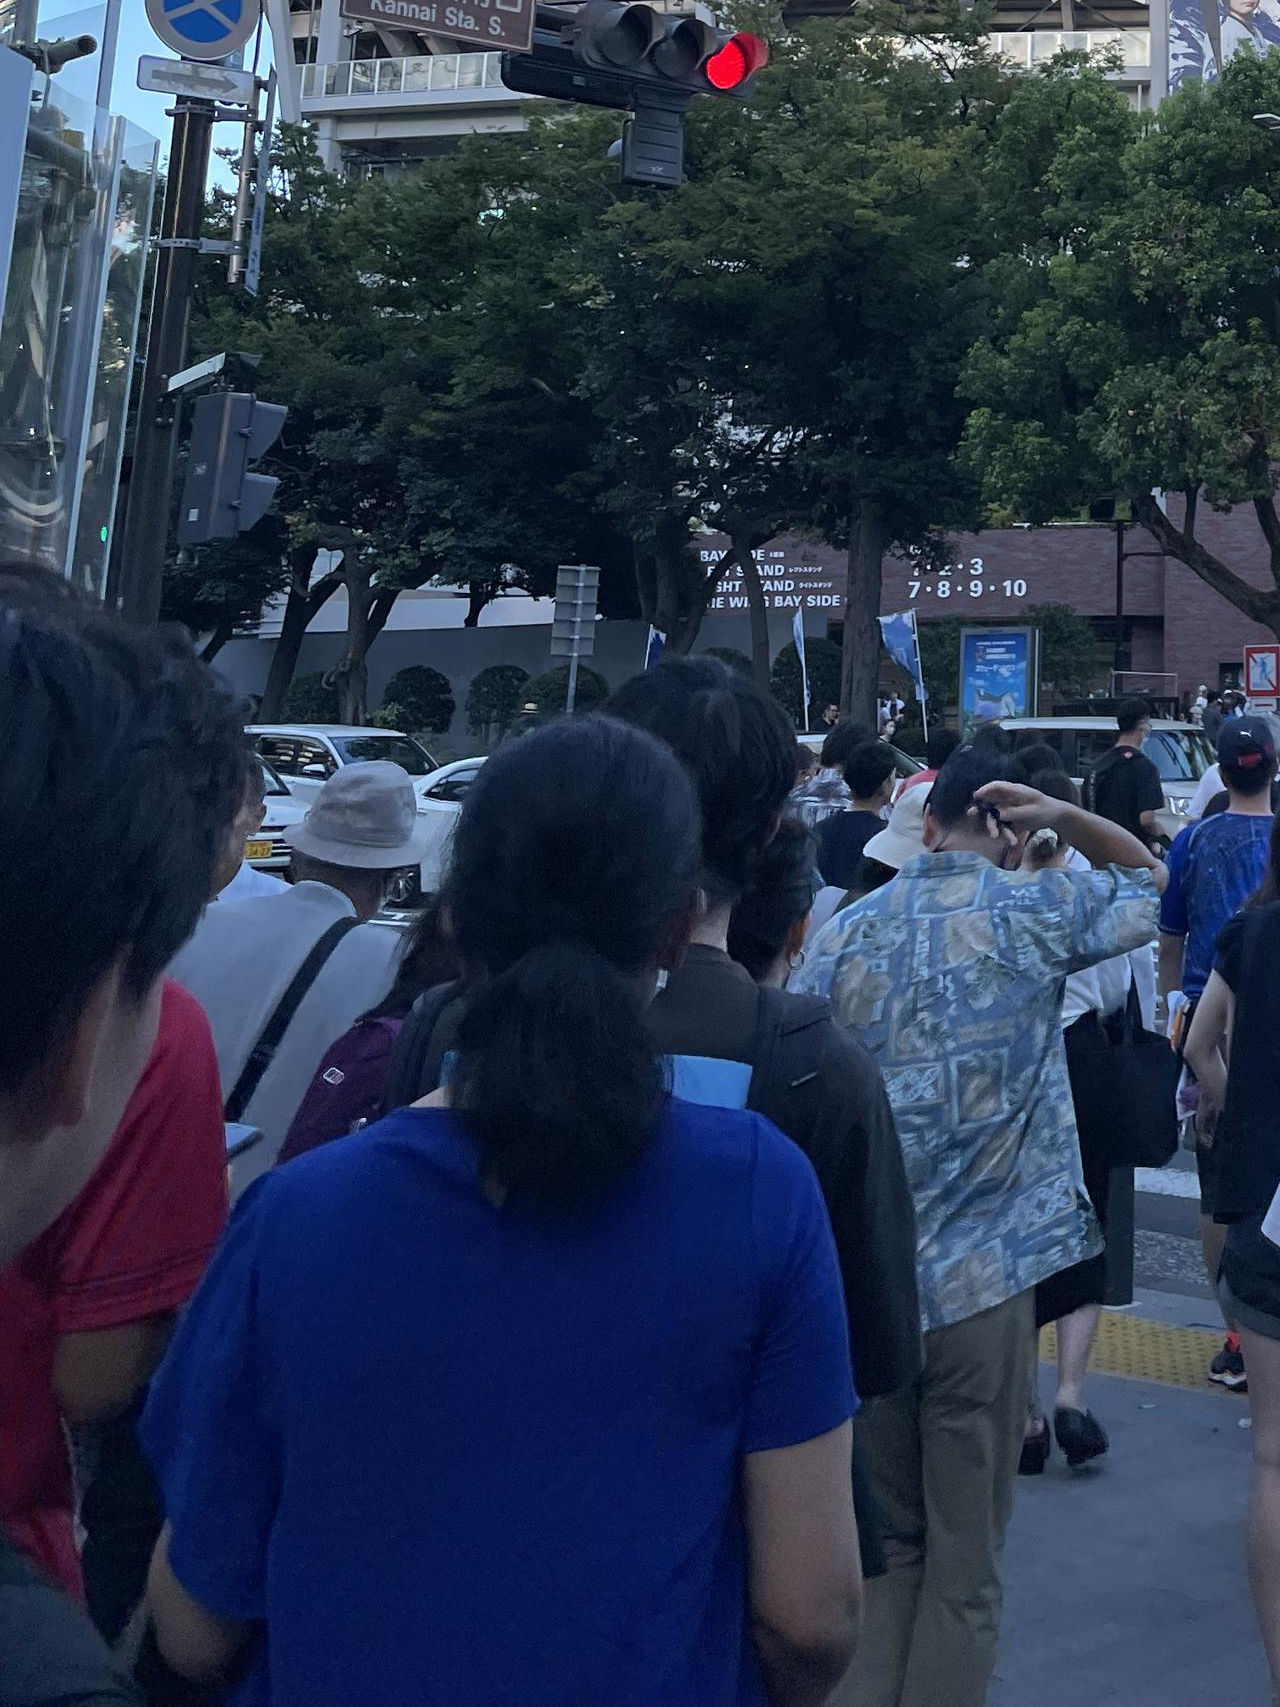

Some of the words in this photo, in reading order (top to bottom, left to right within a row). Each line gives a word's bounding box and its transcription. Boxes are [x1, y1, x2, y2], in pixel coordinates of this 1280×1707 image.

[445, 6, 480, 31] Sta.
[488, 16, 506, 37] S.
[774, 596, 803, 607] BAY
[806, 595, 841, 606] SIDE
